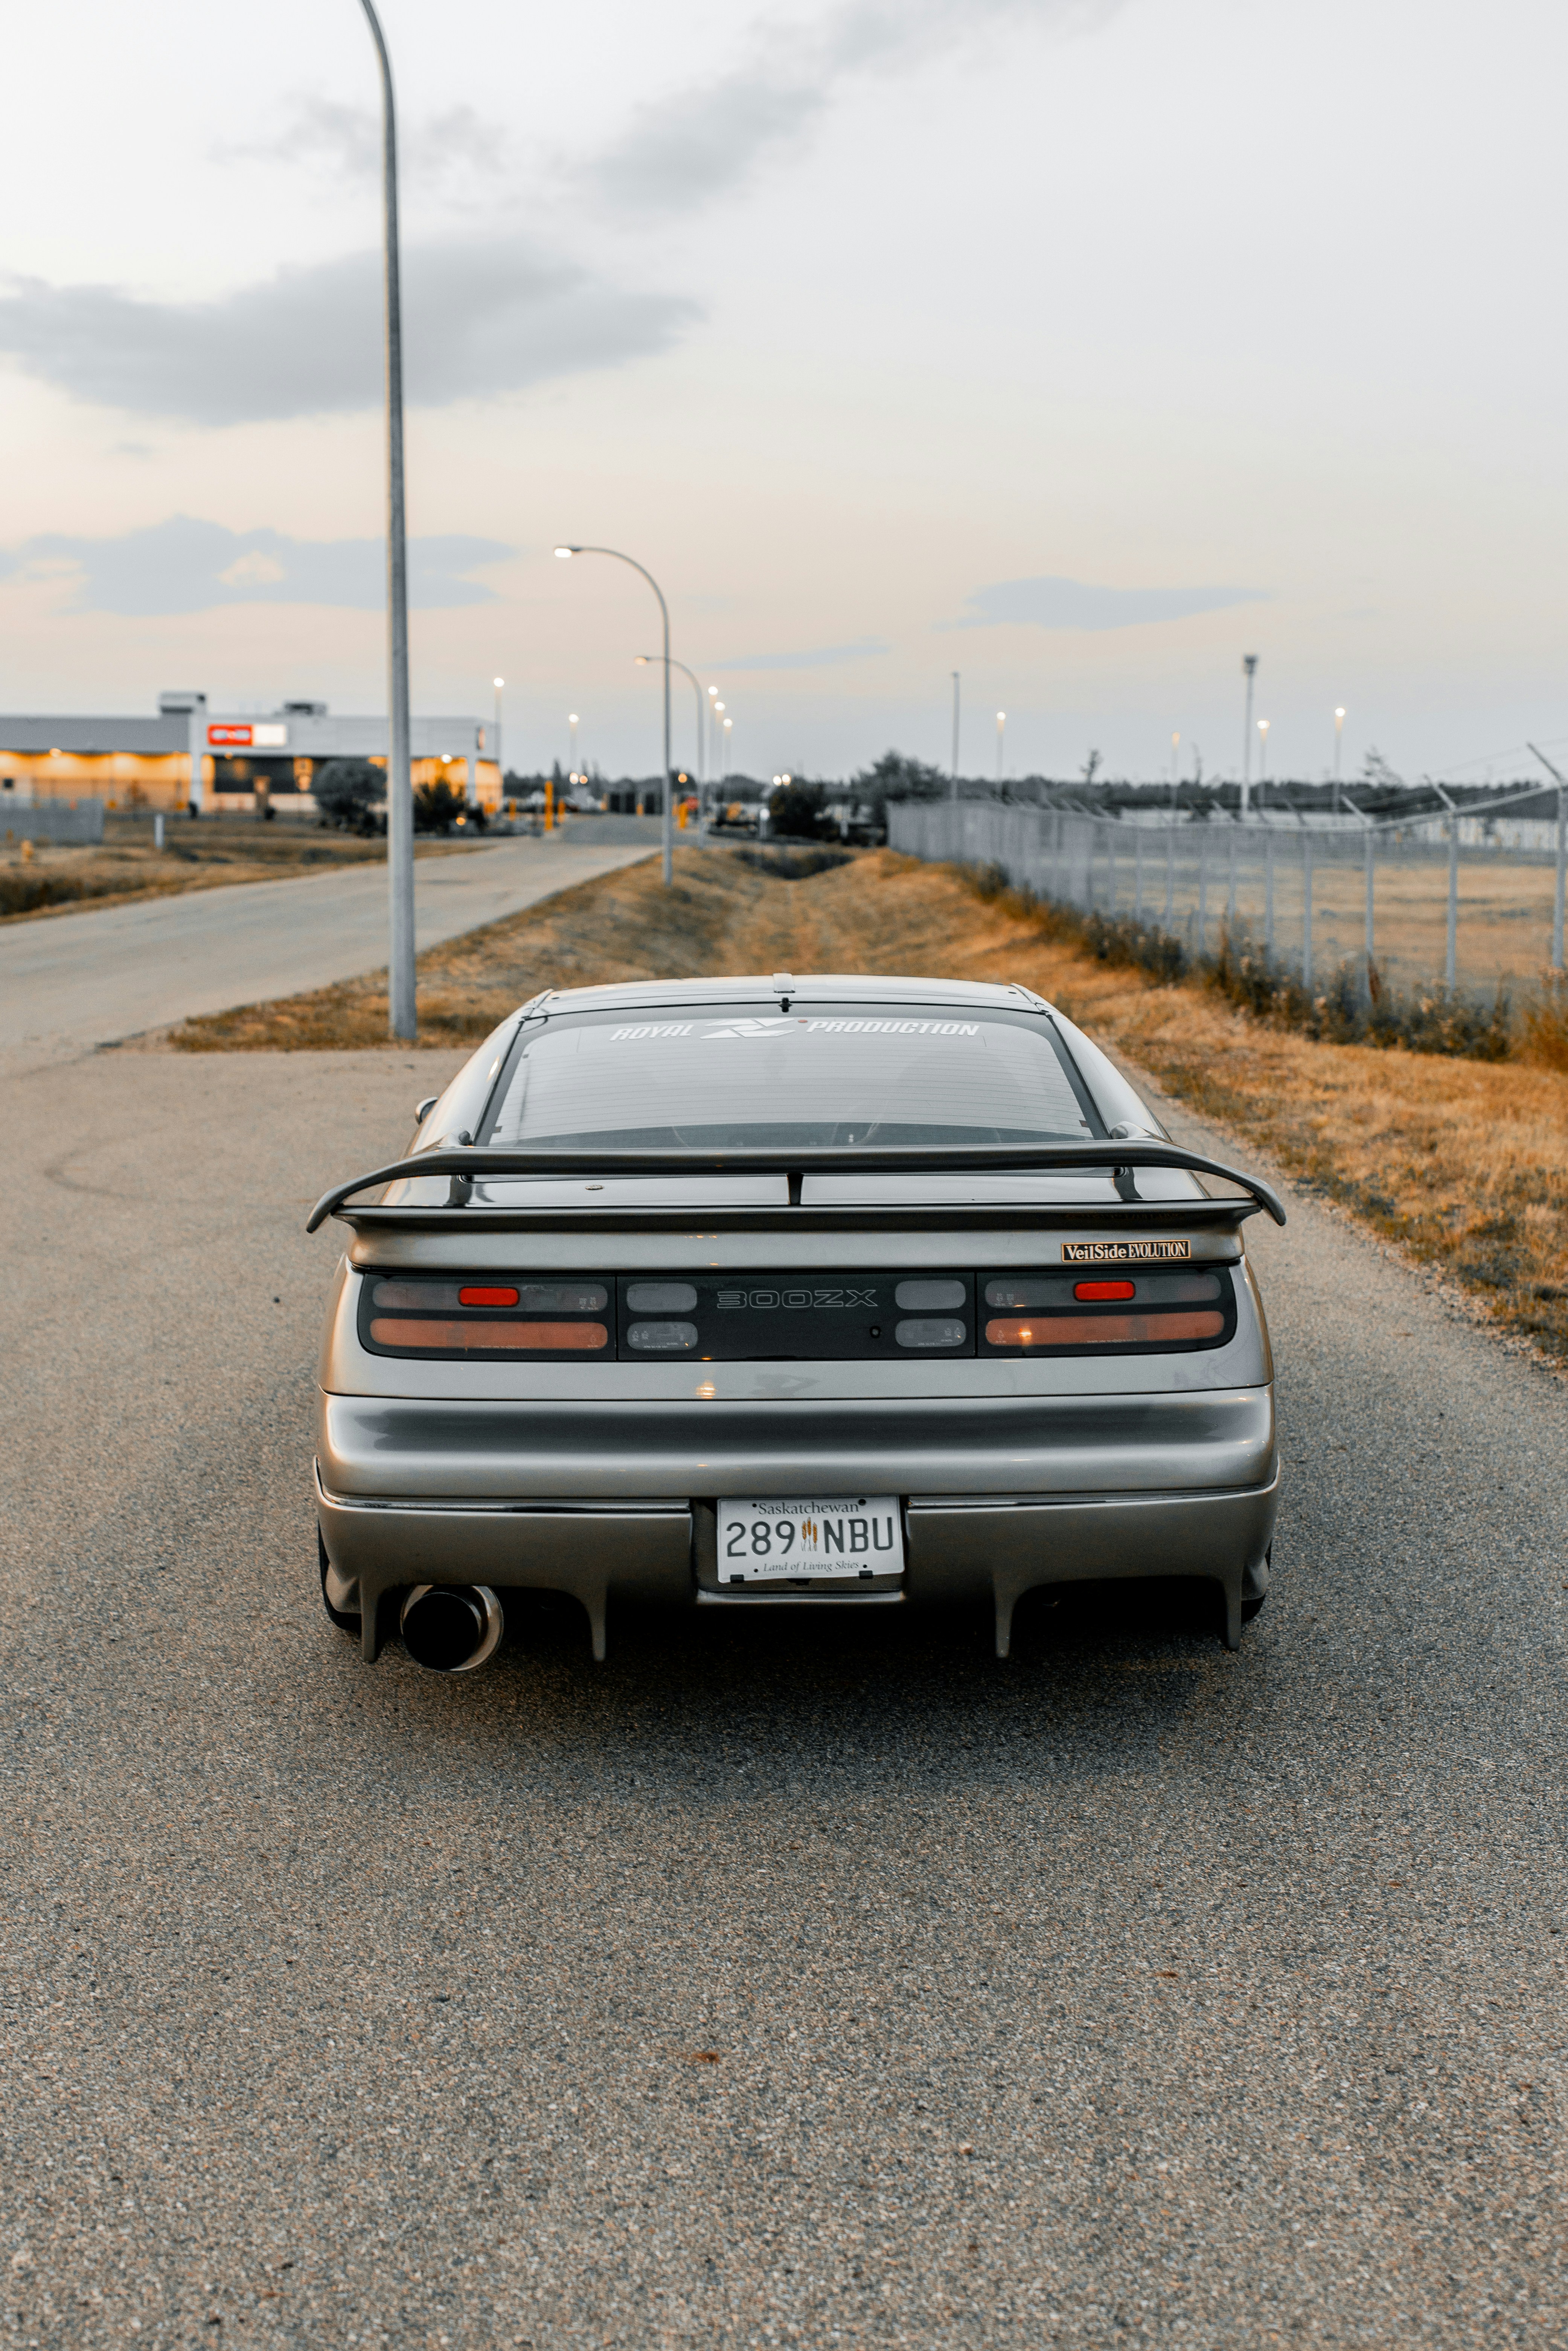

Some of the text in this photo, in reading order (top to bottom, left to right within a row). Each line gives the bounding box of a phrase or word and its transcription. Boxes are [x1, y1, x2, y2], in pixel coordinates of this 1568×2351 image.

[609, 1021, 980, 1041] ROYAL PRODUCTION
[1066, 1242, 1186, 1259] VeilSide EVOLUTION
[717, 1290, 878, 1308] 300ZX
[759, 1502, 859, 1515] Saskatchewan
[726, 1517, 893, 1557] 289 NBU
[763, 1560, 859, 1572] Land of Living Skies
